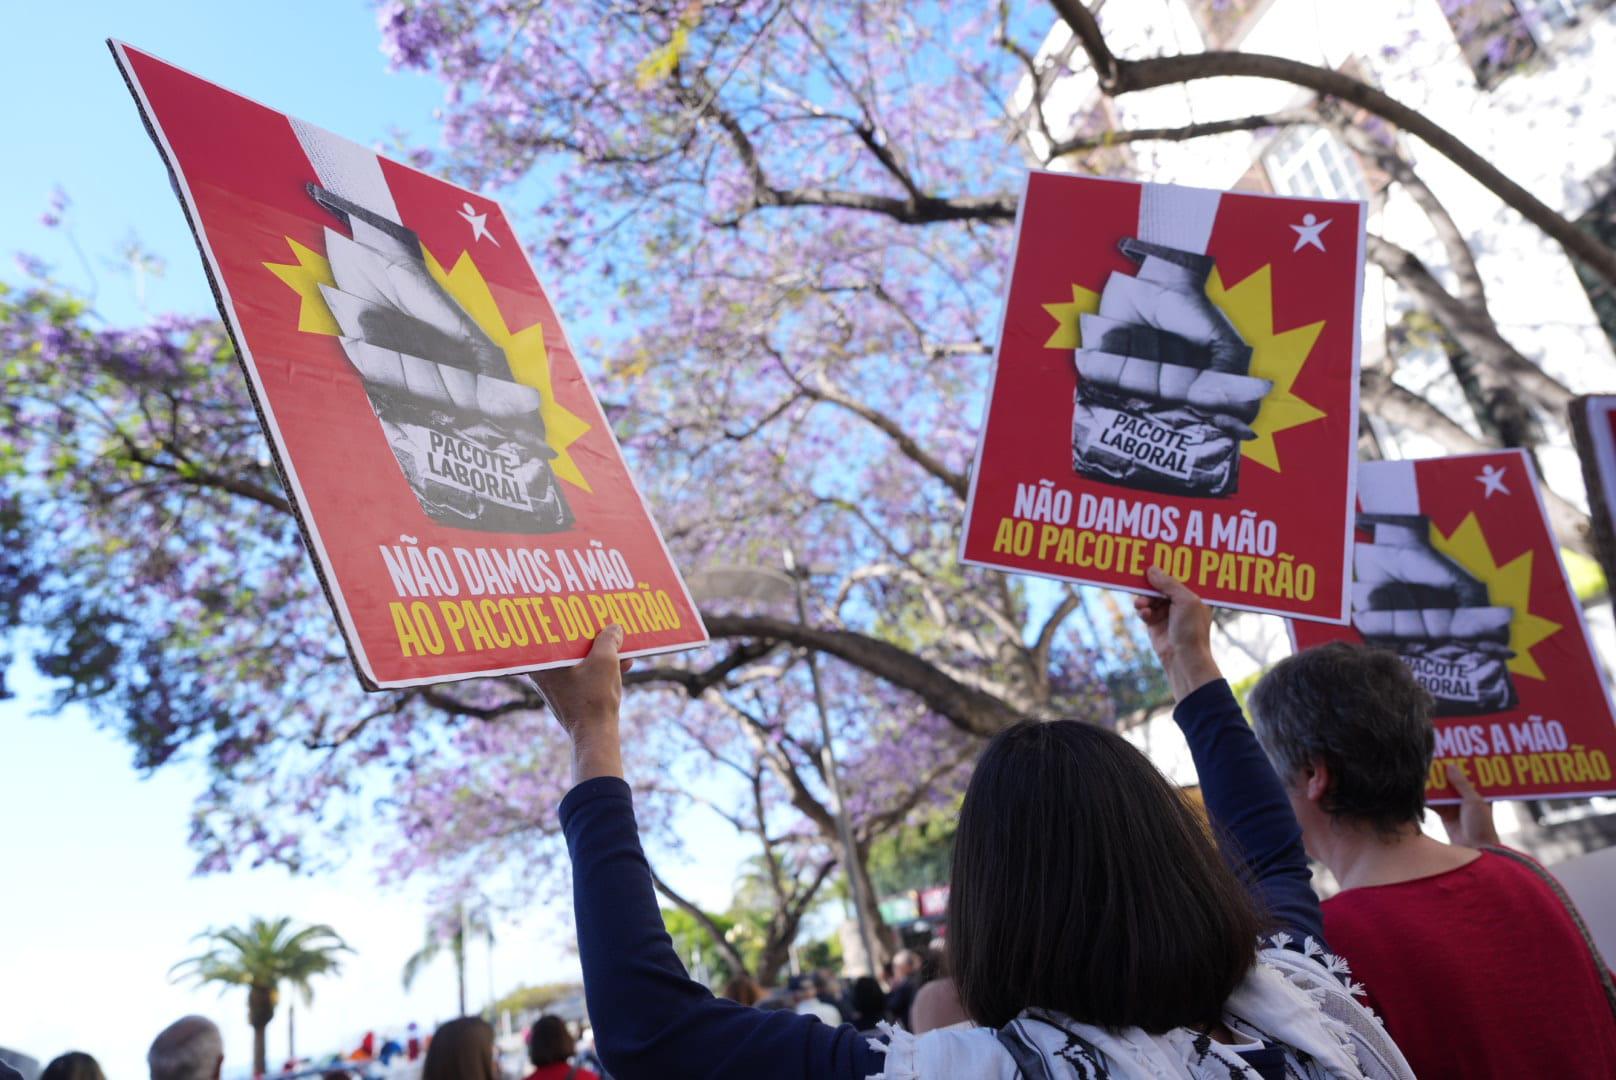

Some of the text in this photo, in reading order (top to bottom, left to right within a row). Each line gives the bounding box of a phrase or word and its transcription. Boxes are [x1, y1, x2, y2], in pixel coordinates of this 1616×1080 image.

[429, 431, 515, 478] PACOTE
[1099, 427, 1188, 474] LABORAL
[1111, 413, 1193, 452] PACOTE
[427, 452, 532, 505] LABORAL
[1013, 478, 1277, 557] NÃO DAMOS A MÃO
[379, 534, 635, 597] NÃO DAMOS A MÃO
[993, 517, 1316, 602] AO PACOTE DO PATRÃO
[389, 581, 681, 657] AO PACOTE DO PATRÃO
[1417, 675, 1475, 697] BORAL
[1432, 714, 1569, 758] MOS A MÃO
[1474, 755, 1512, 788] DO
[1512, 743, 1612, 785] PATRÃO
